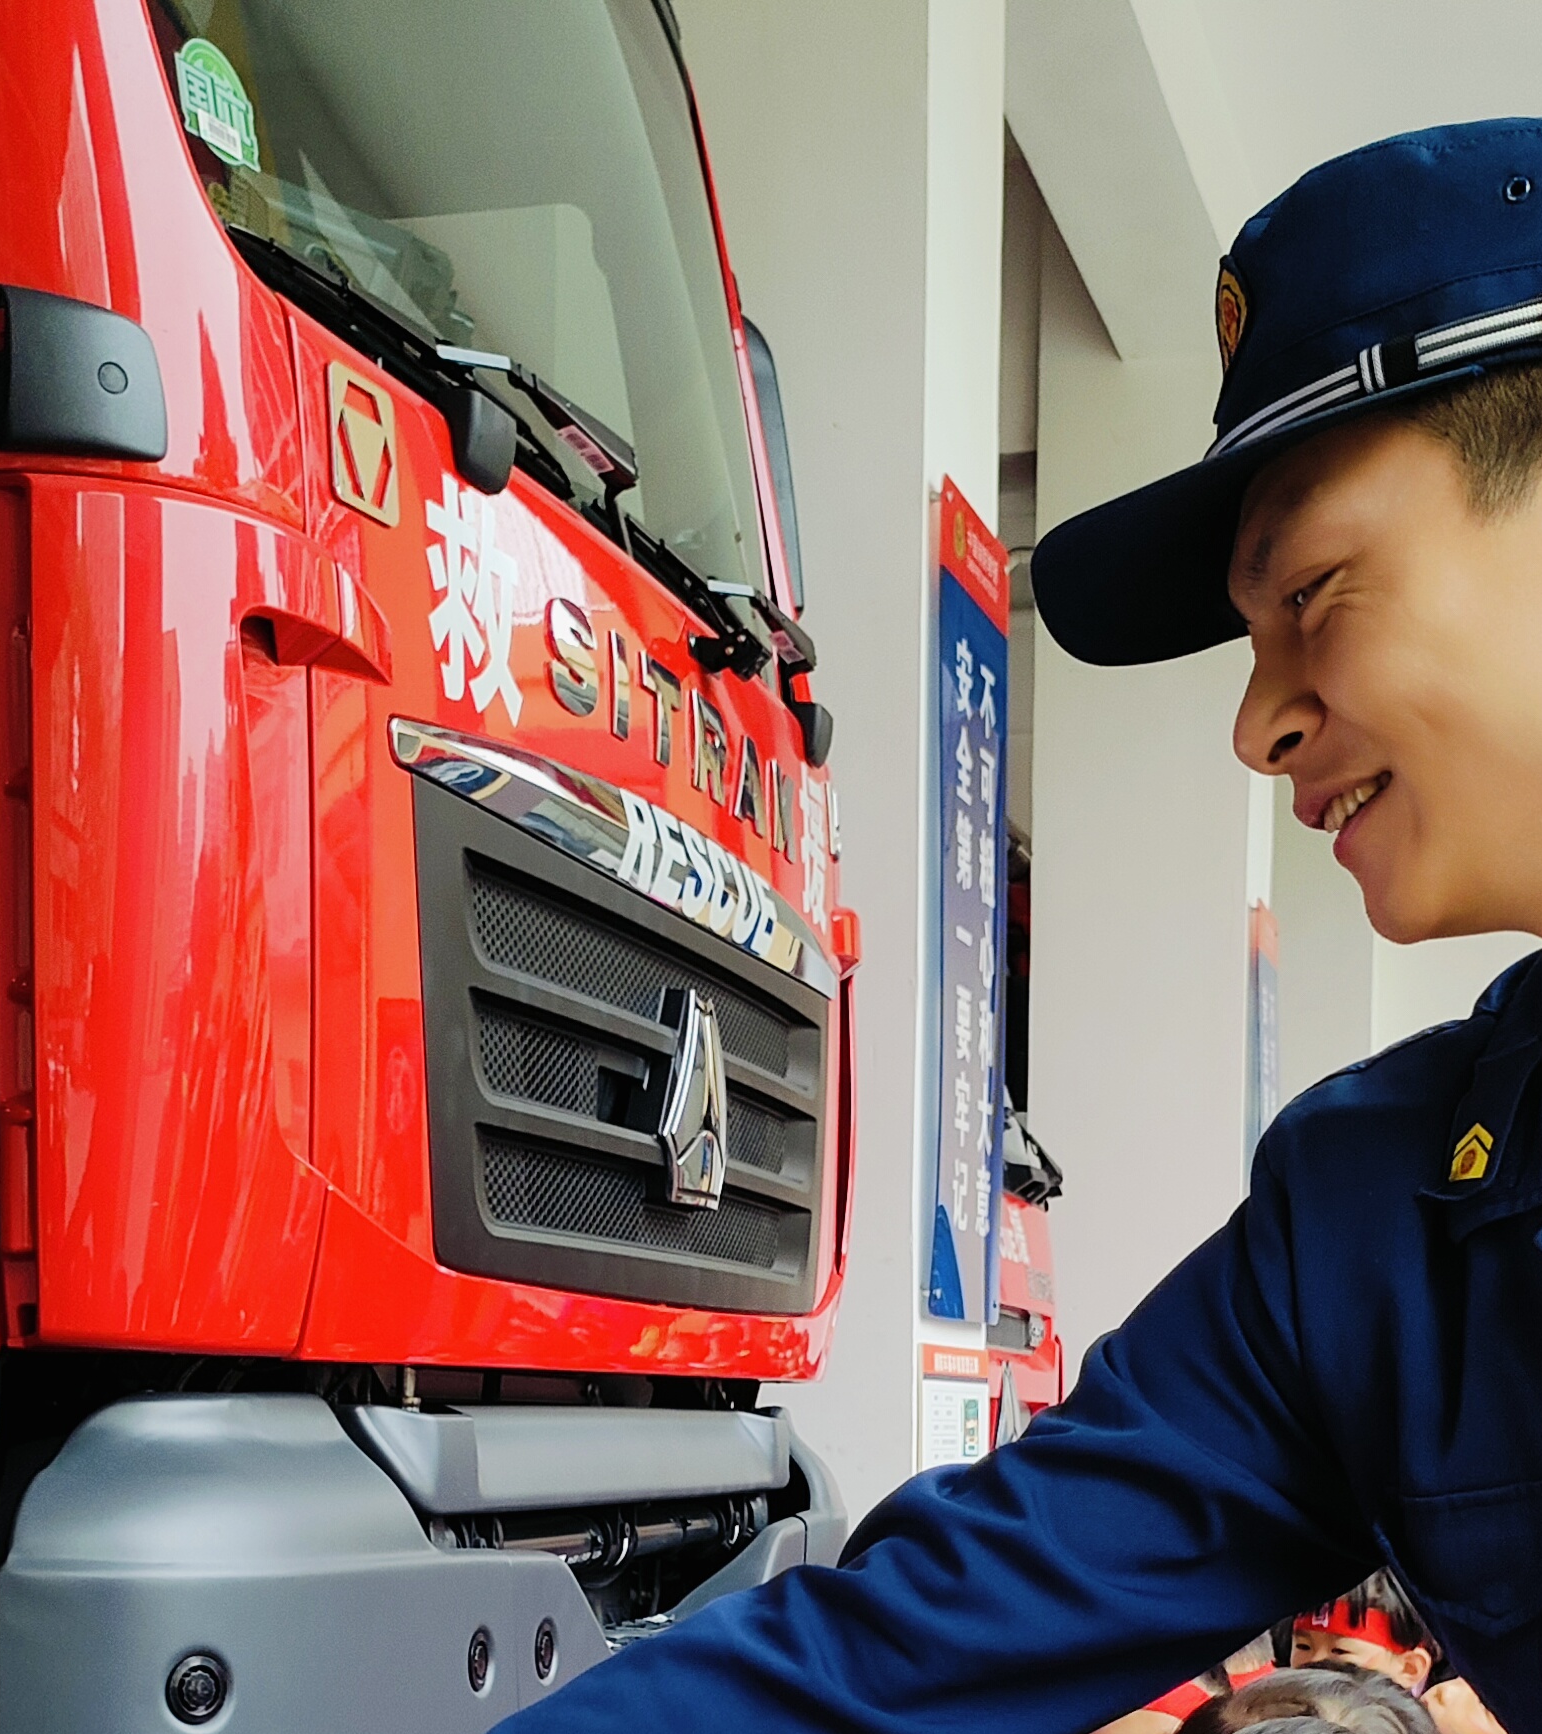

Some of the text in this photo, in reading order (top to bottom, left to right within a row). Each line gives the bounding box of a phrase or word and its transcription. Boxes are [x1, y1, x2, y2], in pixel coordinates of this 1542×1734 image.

[424, 472, 524, 727] 救
[544, 597, 795, 865] SITRAK
[617, 787, 778, 957] RESCUE
